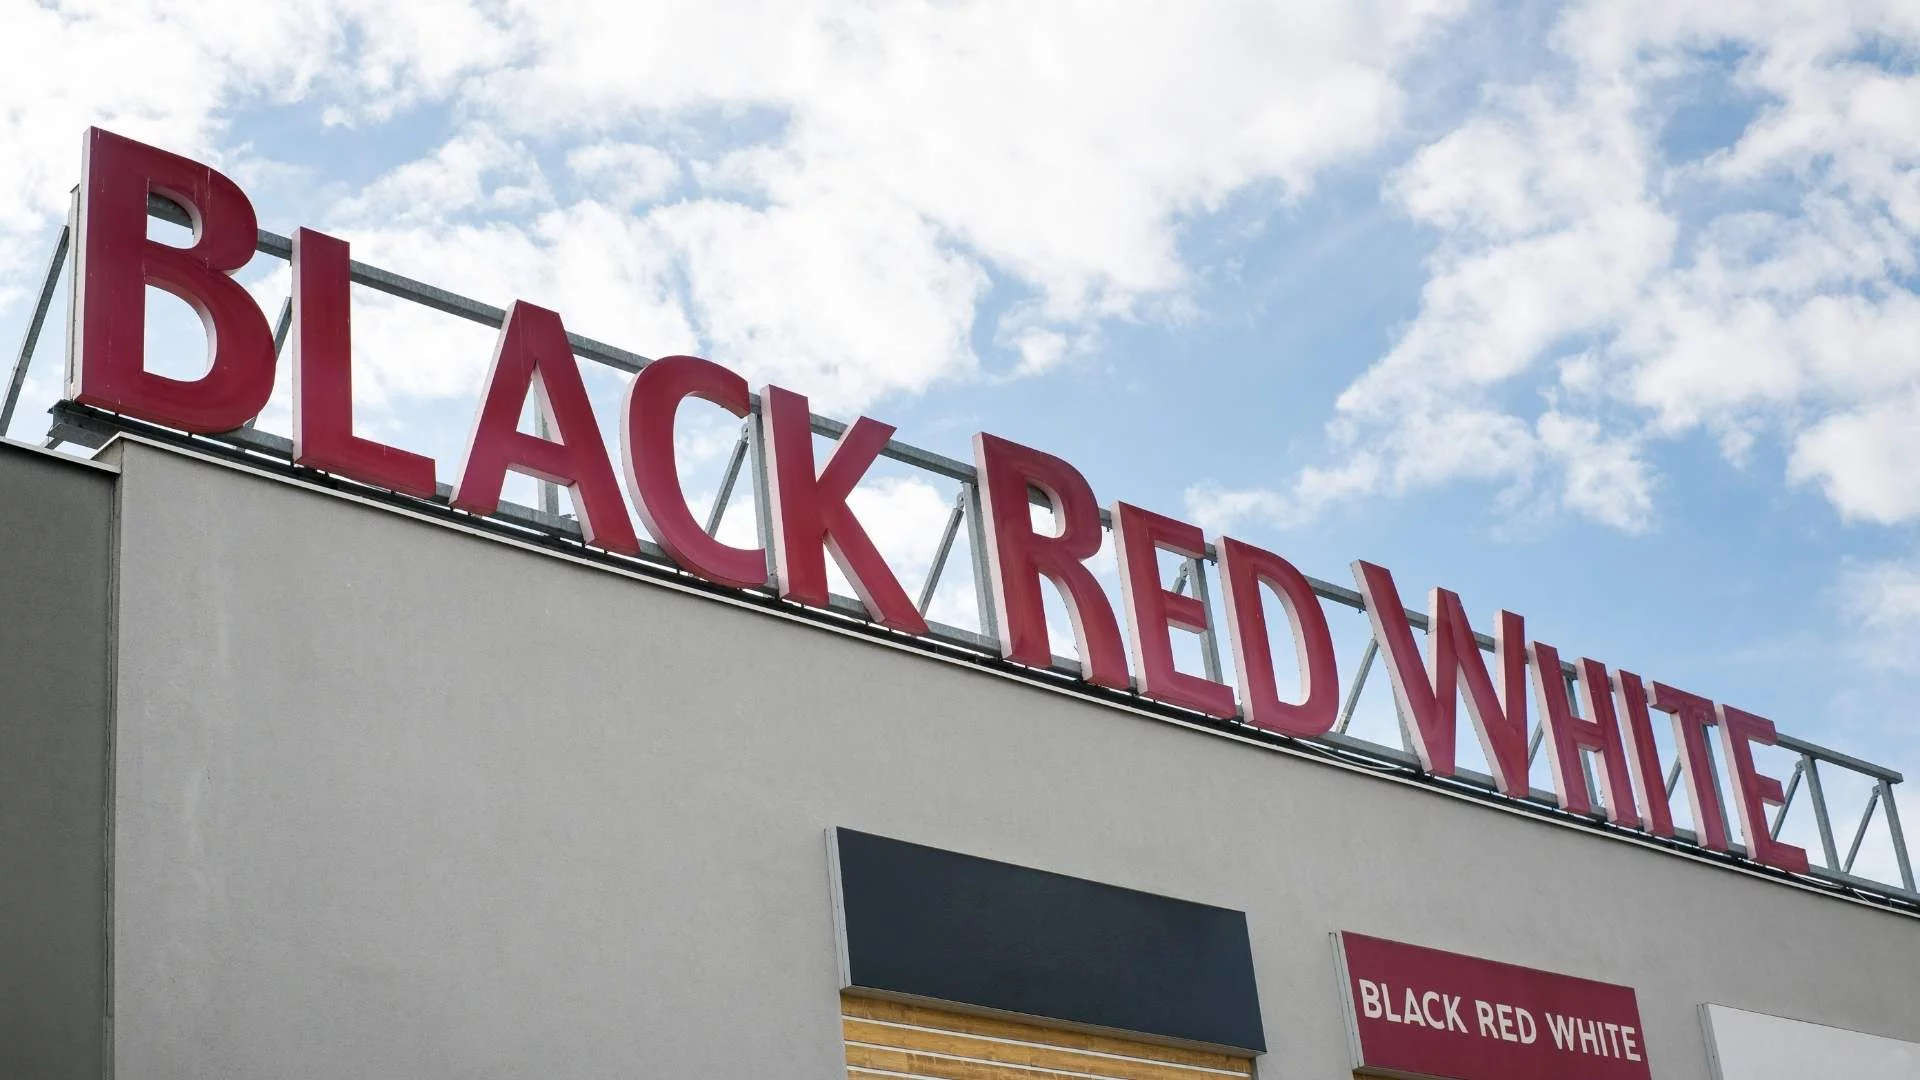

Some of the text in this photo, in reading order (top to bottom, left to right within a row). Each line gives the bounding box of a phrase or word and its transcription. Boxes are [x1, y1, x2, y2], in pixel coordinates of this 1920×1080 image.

[75, 127, 1809, 874] BLACK RED WHITE
[1358, 978, 1641, 1062] BLACK RED WHITE
